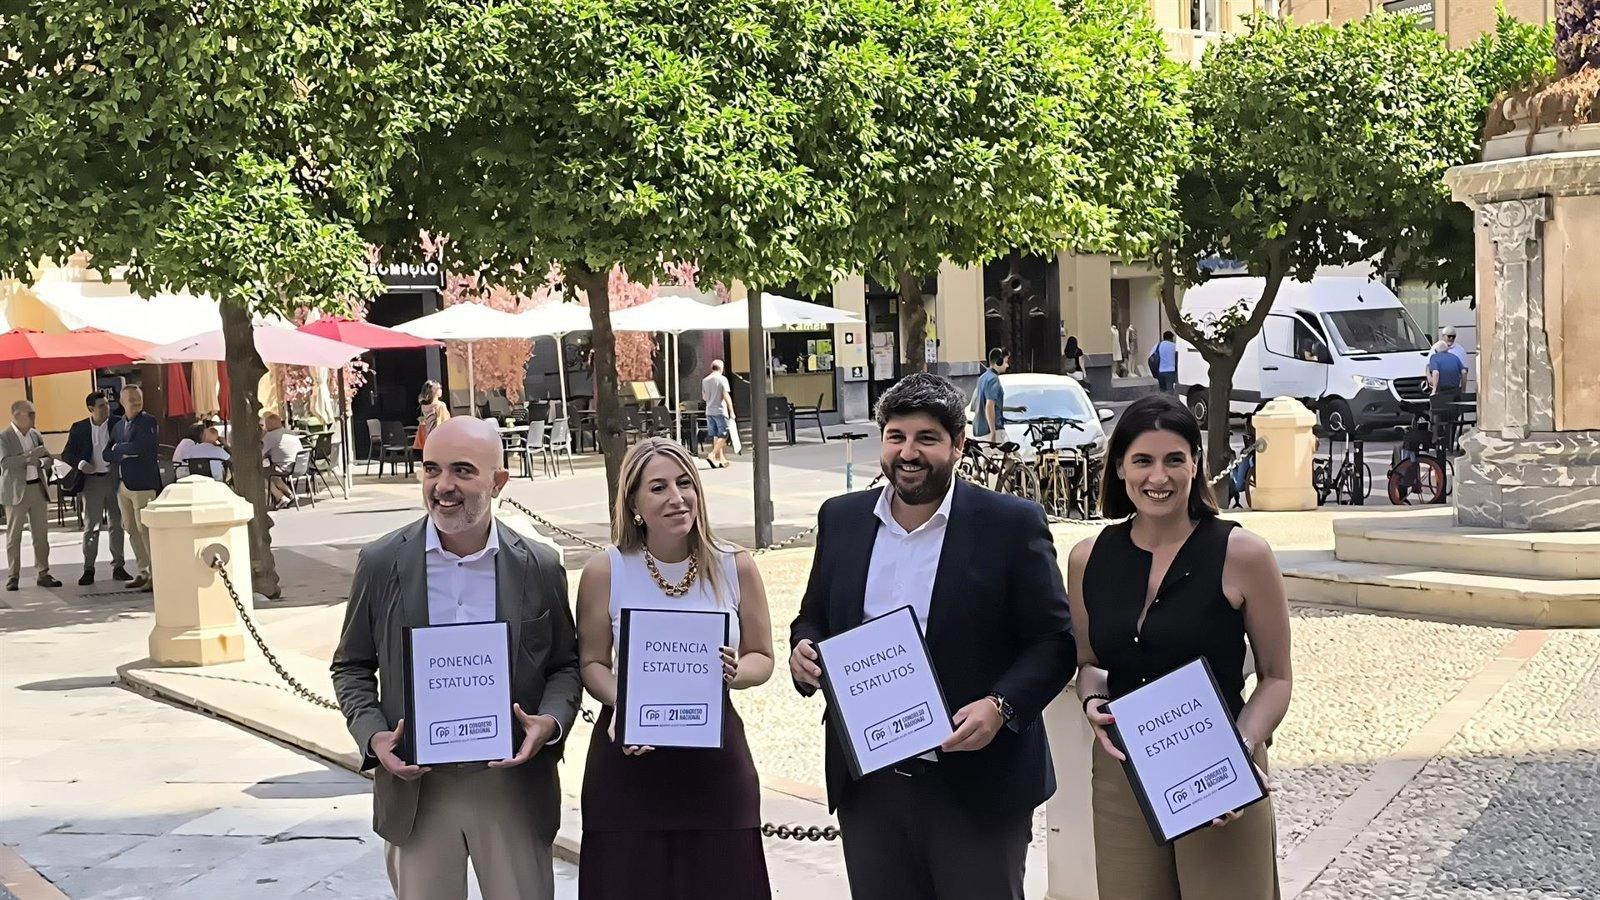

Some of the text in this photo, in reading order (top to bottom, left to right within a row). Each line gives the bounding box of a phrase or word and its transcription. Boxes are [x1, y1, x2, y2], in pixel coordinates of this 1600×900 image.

[646, 641, 707, 653] PONENCIA
[430, 655, 492, 668] PONENCIA
[844, 644, 906, 676] PONENCIA
[643, 662, 709, 674] ESTATUTOS
[429, 675, 495, 690] ESTATUTOS
[850, 663, 915, 696] ESTATUTOS
[669, 709, 679, 721] 21
[1138, 699, 1202, 736] PONENCIA
[458, 723, 468, 736] 21
[892, 719, 904, 733] 21
[1145, 718, 1213, 757] ESTATUTOS
[1194, 778, 1207, 794] 21
